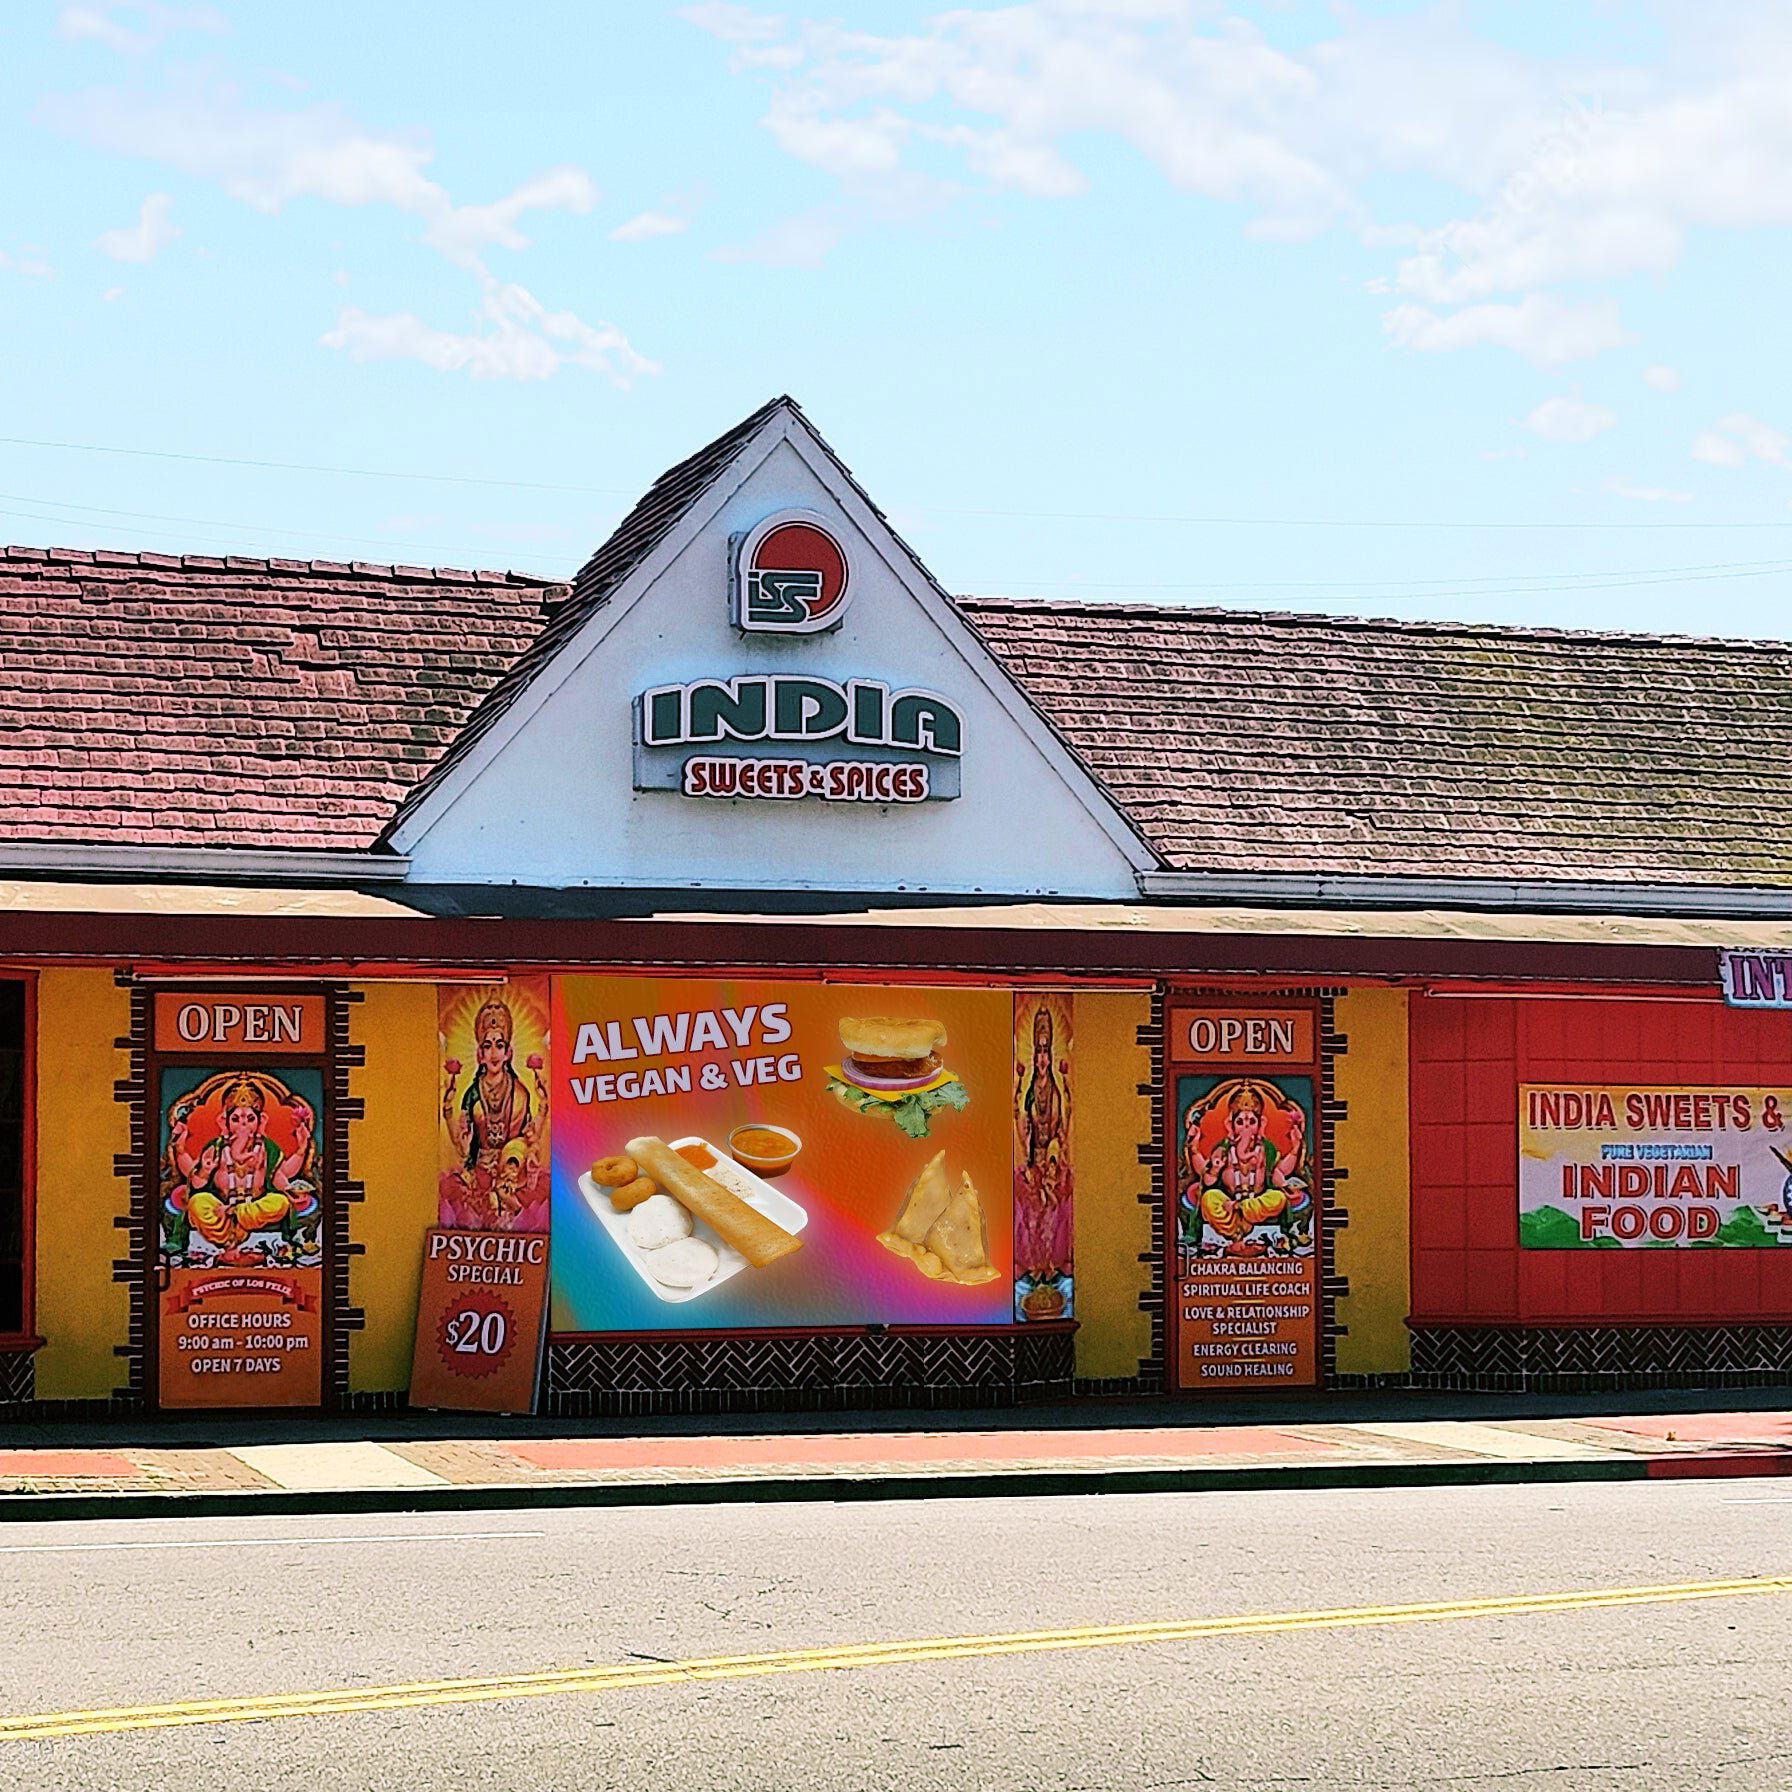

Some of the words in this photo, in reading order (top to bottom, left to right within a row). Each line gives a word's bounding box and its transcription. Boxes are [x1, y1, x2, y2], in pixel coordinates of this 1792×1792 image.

[649, 678, 962, 753] INDIA
[690, 761, 804, 796] SWEETS
[808, 769, 826, 790] &
[829, 766, 924, 799] SPICES
[177, 1003, 302, 1042] OPEN
[572, 1003, 793, 1064] ALWAYS
[1189, 1018, 1295, 1054] OPEN
[569, 1065, 692, 1105] VEGAN
[700, 1063, 729, 1091] &
[731, 1054, 803, 1087] VEG
[1528, 1092, 1617, 1130] INDIA
[1625, 1093, 1752, 1131] SWEETS
[1762, 1094, 1785, 1130] &
[1562, 1164, 1741, 1199] INDIAN
[1582, 1205, 1721, 1240] FOOD
[429, 1234, 544, 1264] PSYCHIC
[447, 1264, 524, 1285] SPECIAL
[1190, 1264, 1237, 1276] CHAKRA
[1238, 1263, 1303, 1275] BALANCING
[1183, 1284, 1243, 1297] SPIRITUAL
[1245, 1284, 1270, 1296] LIFE
[1271, 1283, 1310, 1295] COACH
[188, 1313, 239, 1329] OFFICE
[241, 1313, 292, 1328] HOURS
[1184, 1307, 1214, 1320] LOVE
[1216, 1307, 1225, 1319] &
[1227, 1306, 1310, 1319] RELATIONSHIP
[178, 1335, 210, 1350] 9:00
[211, 1338, 234, 1349] am
[245, 1335, 284, 1349] 10:00
[285, 1336, 309, 1351] pm
[445, 1311, 505, 1354] $20
[1212, 1322, 1278, 1335] SPECIALIST
[1193, 1344, 1240, 1357] ENERGY
[1241, 1343, 1298, 1355] CLEARING
[191, 1358, 231, 1374] OPEN
[233, 1358, 243, 1373] 7
[245, 1358, 282, 1372] DAYS
[1201, 1364, 1242, 1377] SOUND
[1243, 1363, 1294, 1376] HEALING
